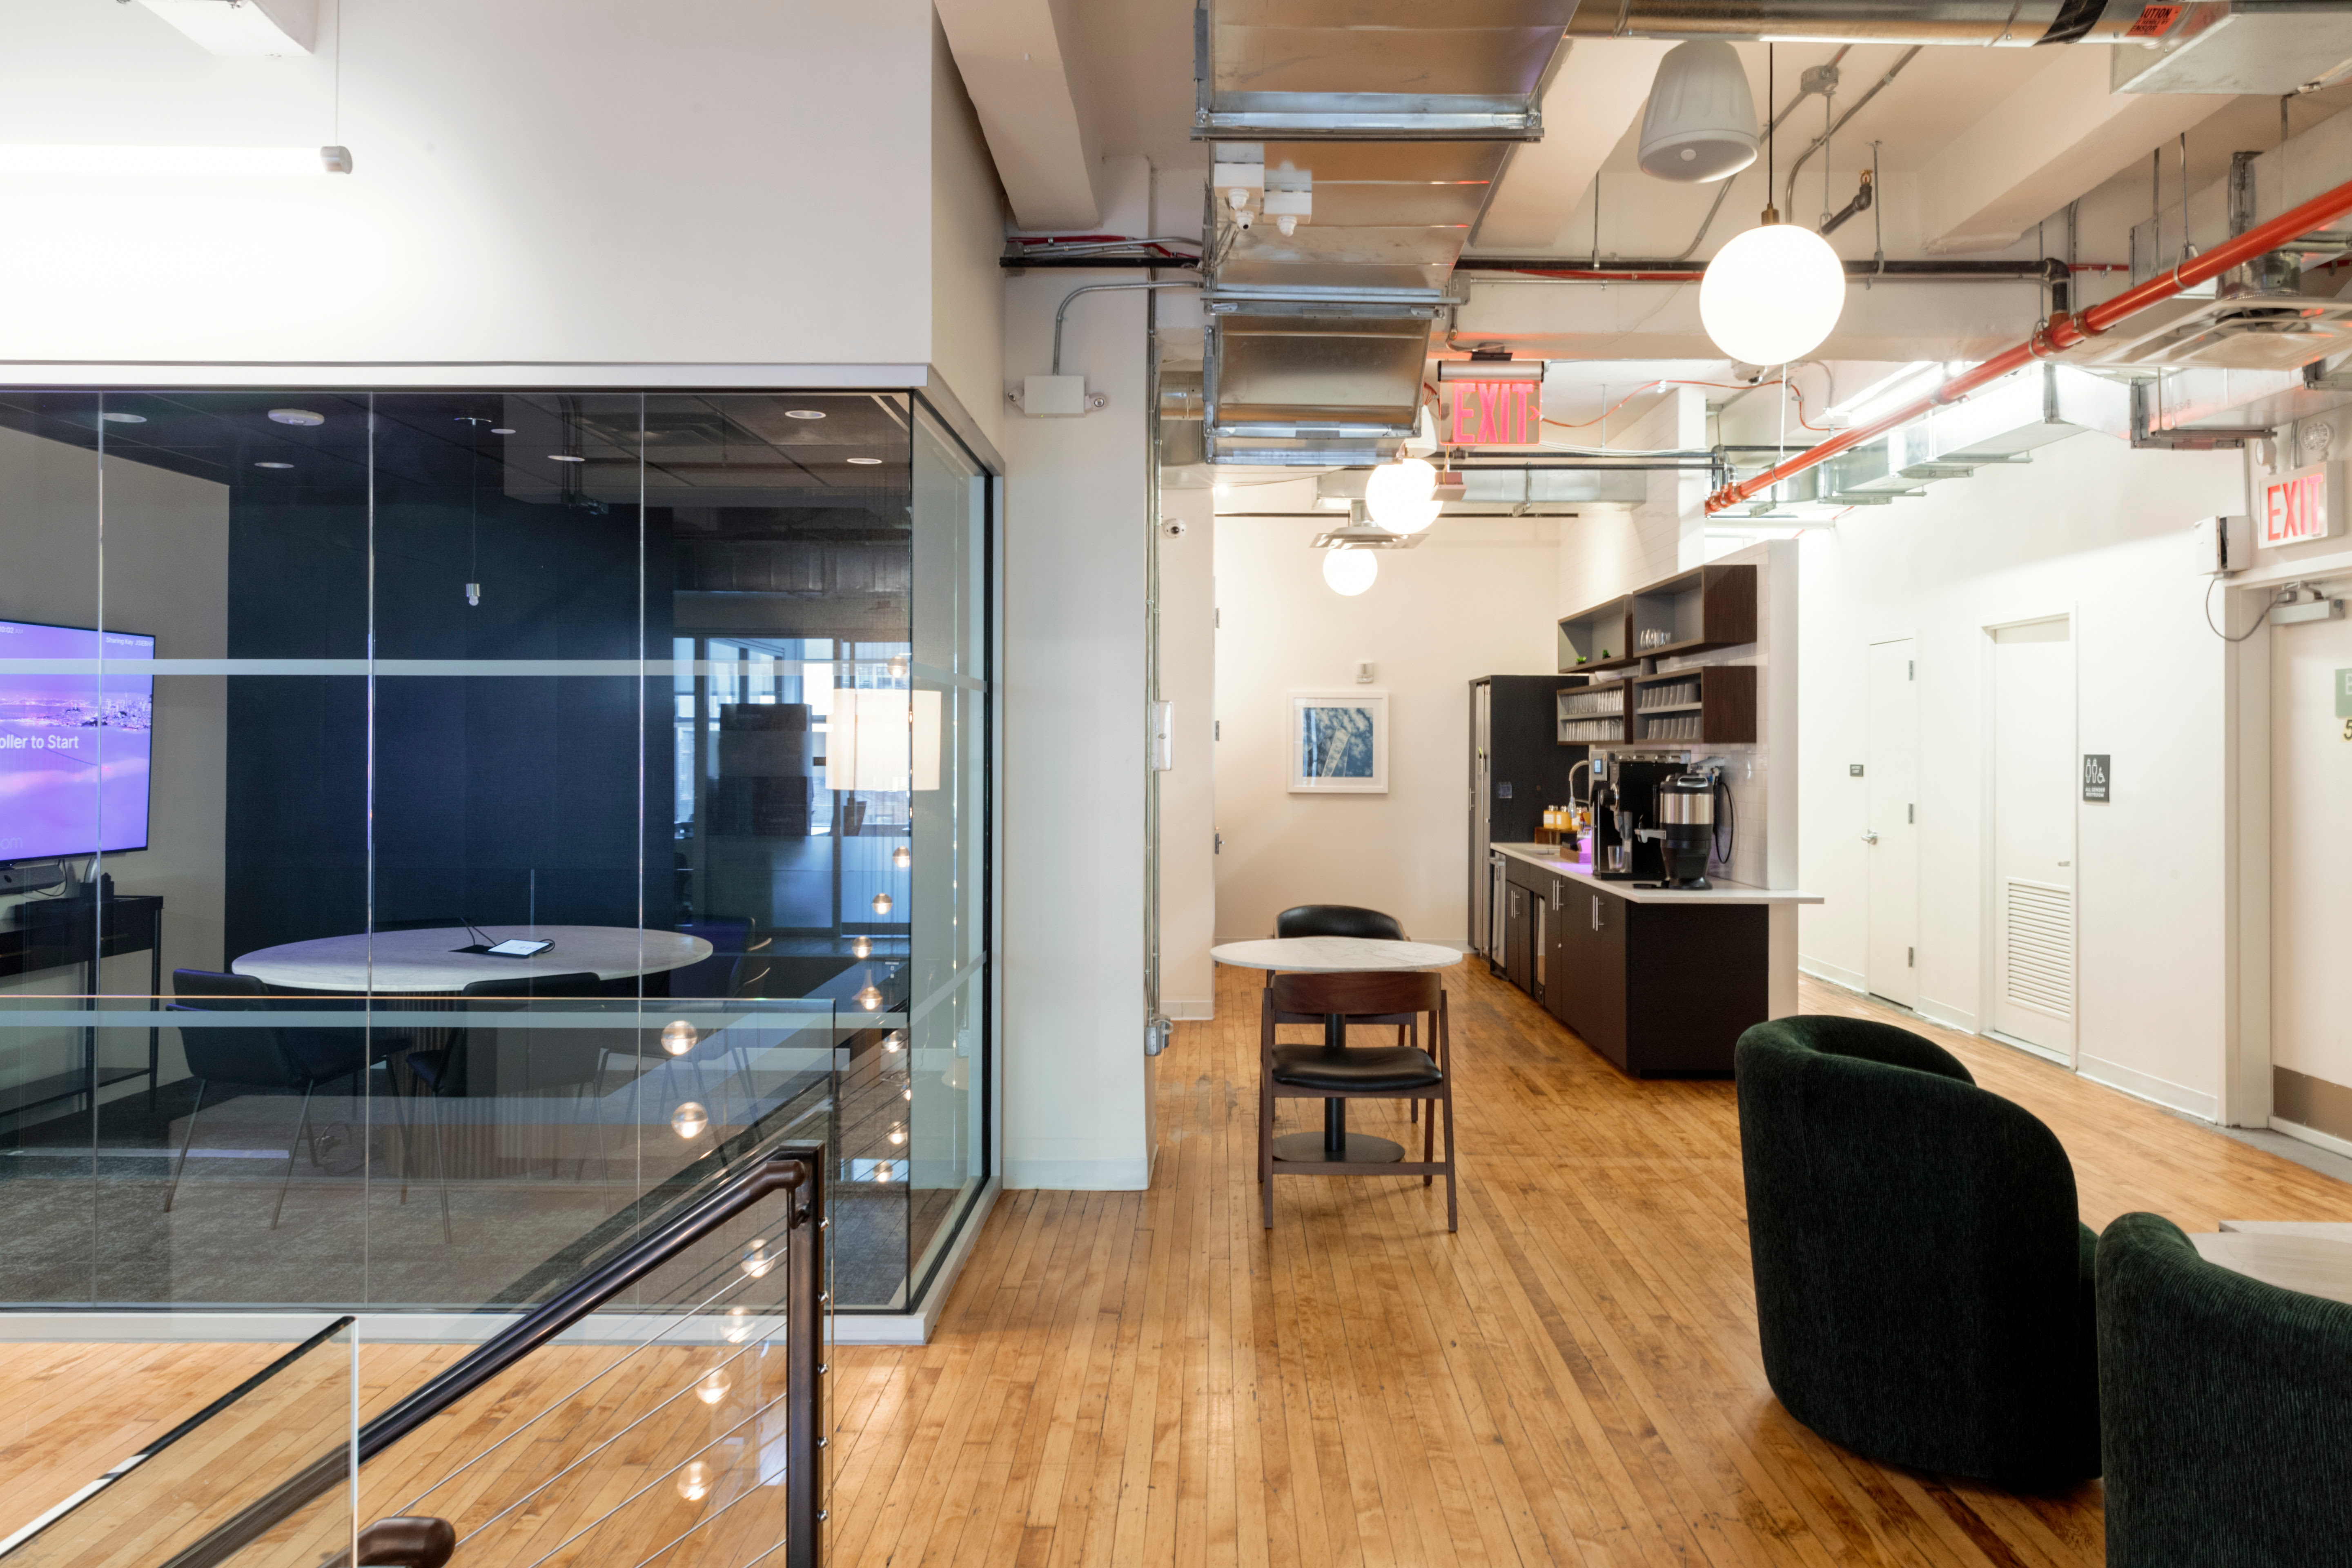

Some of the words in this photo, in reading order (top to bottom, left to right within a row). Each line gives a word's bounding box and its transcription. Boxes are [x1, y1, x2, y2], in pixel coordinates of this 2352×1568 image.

[1452, 383, 1534, 443] EXIT
[2267, 472, 2323, 541] EXIT
[106, 637, 124, 645] Sharing
[31, 735, 45, 748] to
[47, 735, 79, 748] Start
[0, 837, 23, 850] om
